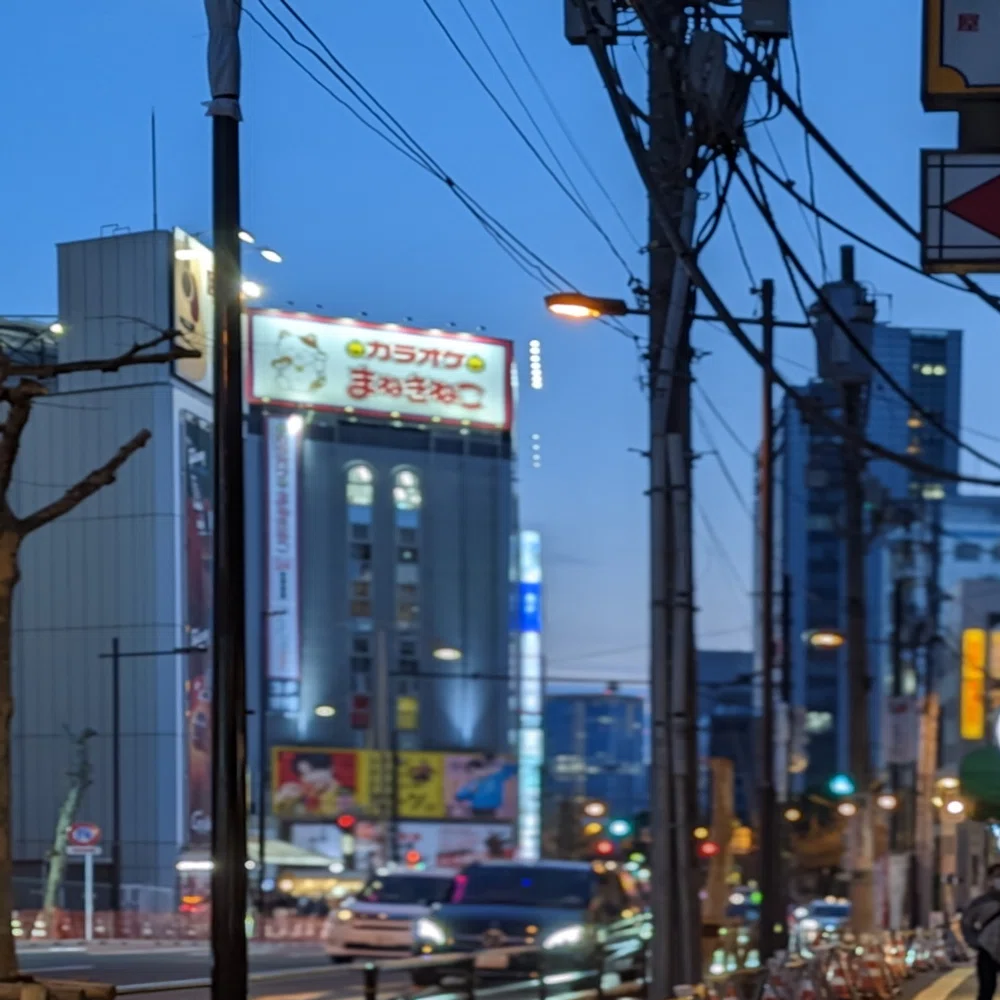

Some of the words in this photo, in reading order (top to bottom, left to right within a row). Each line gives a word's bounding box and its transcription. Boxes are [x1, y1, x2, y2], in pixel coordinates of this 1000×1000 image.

[367, 340, 466, 369] カラオケ
[346, 365, 485, 410] まねきねこ
